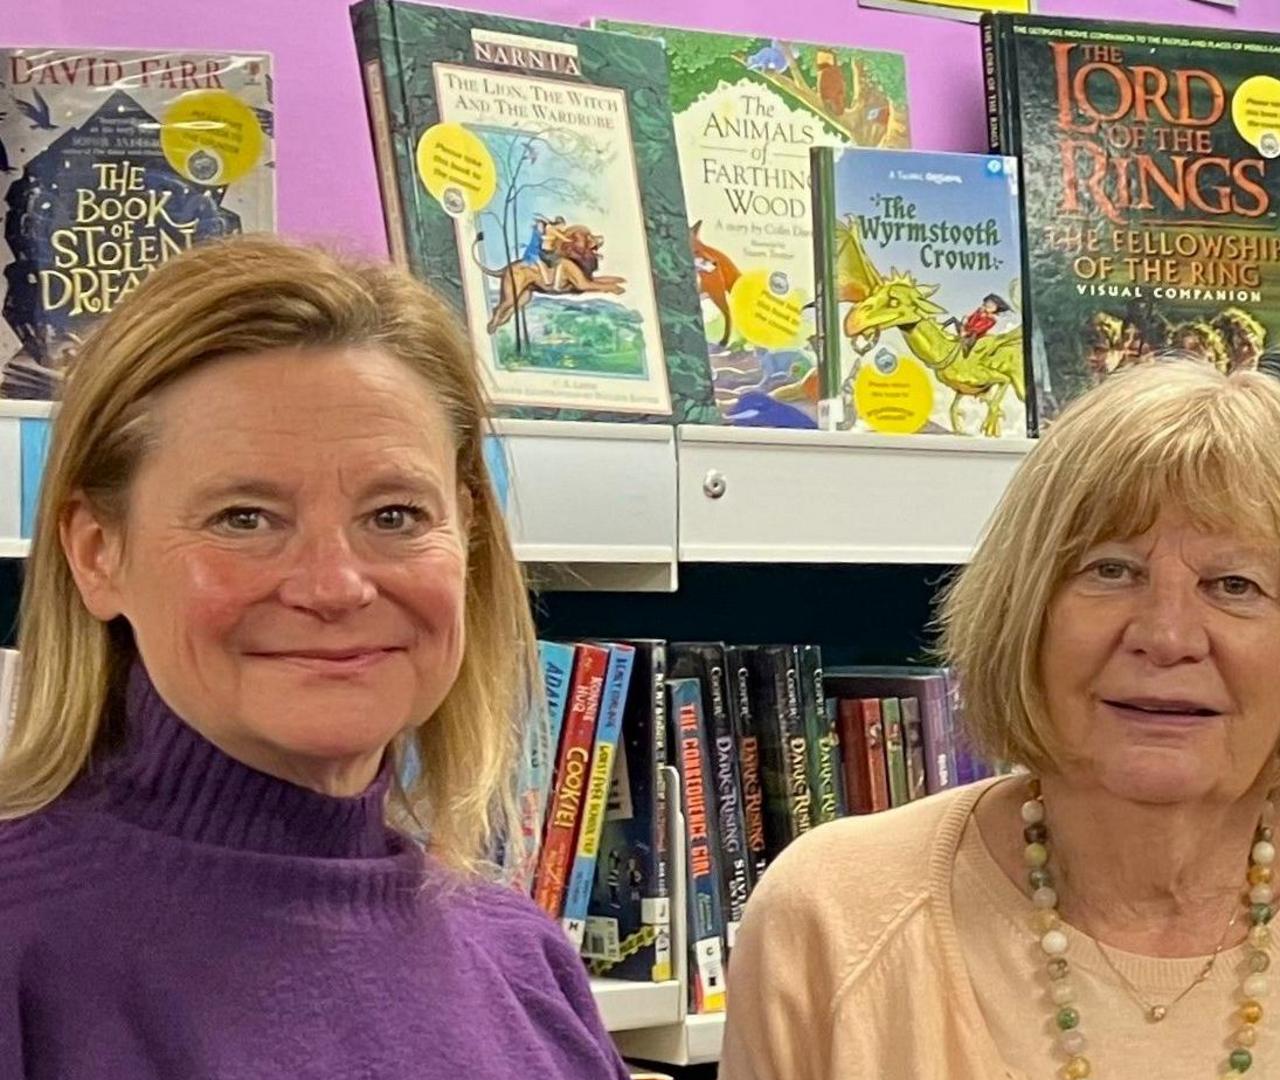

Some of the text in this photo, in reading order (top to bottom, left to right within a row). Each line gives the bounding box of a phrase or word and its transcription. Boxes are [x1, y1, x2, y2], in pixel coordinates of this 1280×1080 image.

[474, 42, 582, 76] NARNIA
[1080, 45, 1123, 63] THE
[10, 56, 225, 89] DAVID FARR
[1049, 42, 1225, 133] LORD
[740, 95, 776, 119] The
[703, 112, 815, 144] ANIMALS
[1107, 124, 1213, 154] OF THE
[750, 143, 770, 166] of
[92, 161, 145, 197] THE
[702, 158, 813, 193] FARTHIN
[1058, 139, 1271, 225] RINGS
[76, 188, 200, 229] BOOK
[724, 188, 807, 219] WOOD
[882, 195, 917, 219] The
[858, 214, 1001, 248] Wyrmstooth
[1043, 225, 1101, 255] THE
[51, 226, 197, 273] STOLEN
[920, 244, 993, 270] Crown
[1073, 255, 1263, 289] OF THE RING
[1076, 283, 1262, 303] VISUAL COMPANION
[572, 684, 589, 713] HUQ
[715, 736, 734, 786] DARK
[740, 736, 759, 785] DARK
[789, 736, 808, 787] DARK
[817, 736, 834, 785] DARK
[551, 745, 590, 830] COOKIE!
[679, 702, 697, 732] THE
[691, 845, 710, 880] GIRL
[718, 789, 740, 853] RISING
[742, 787, 765, 853] RISING
